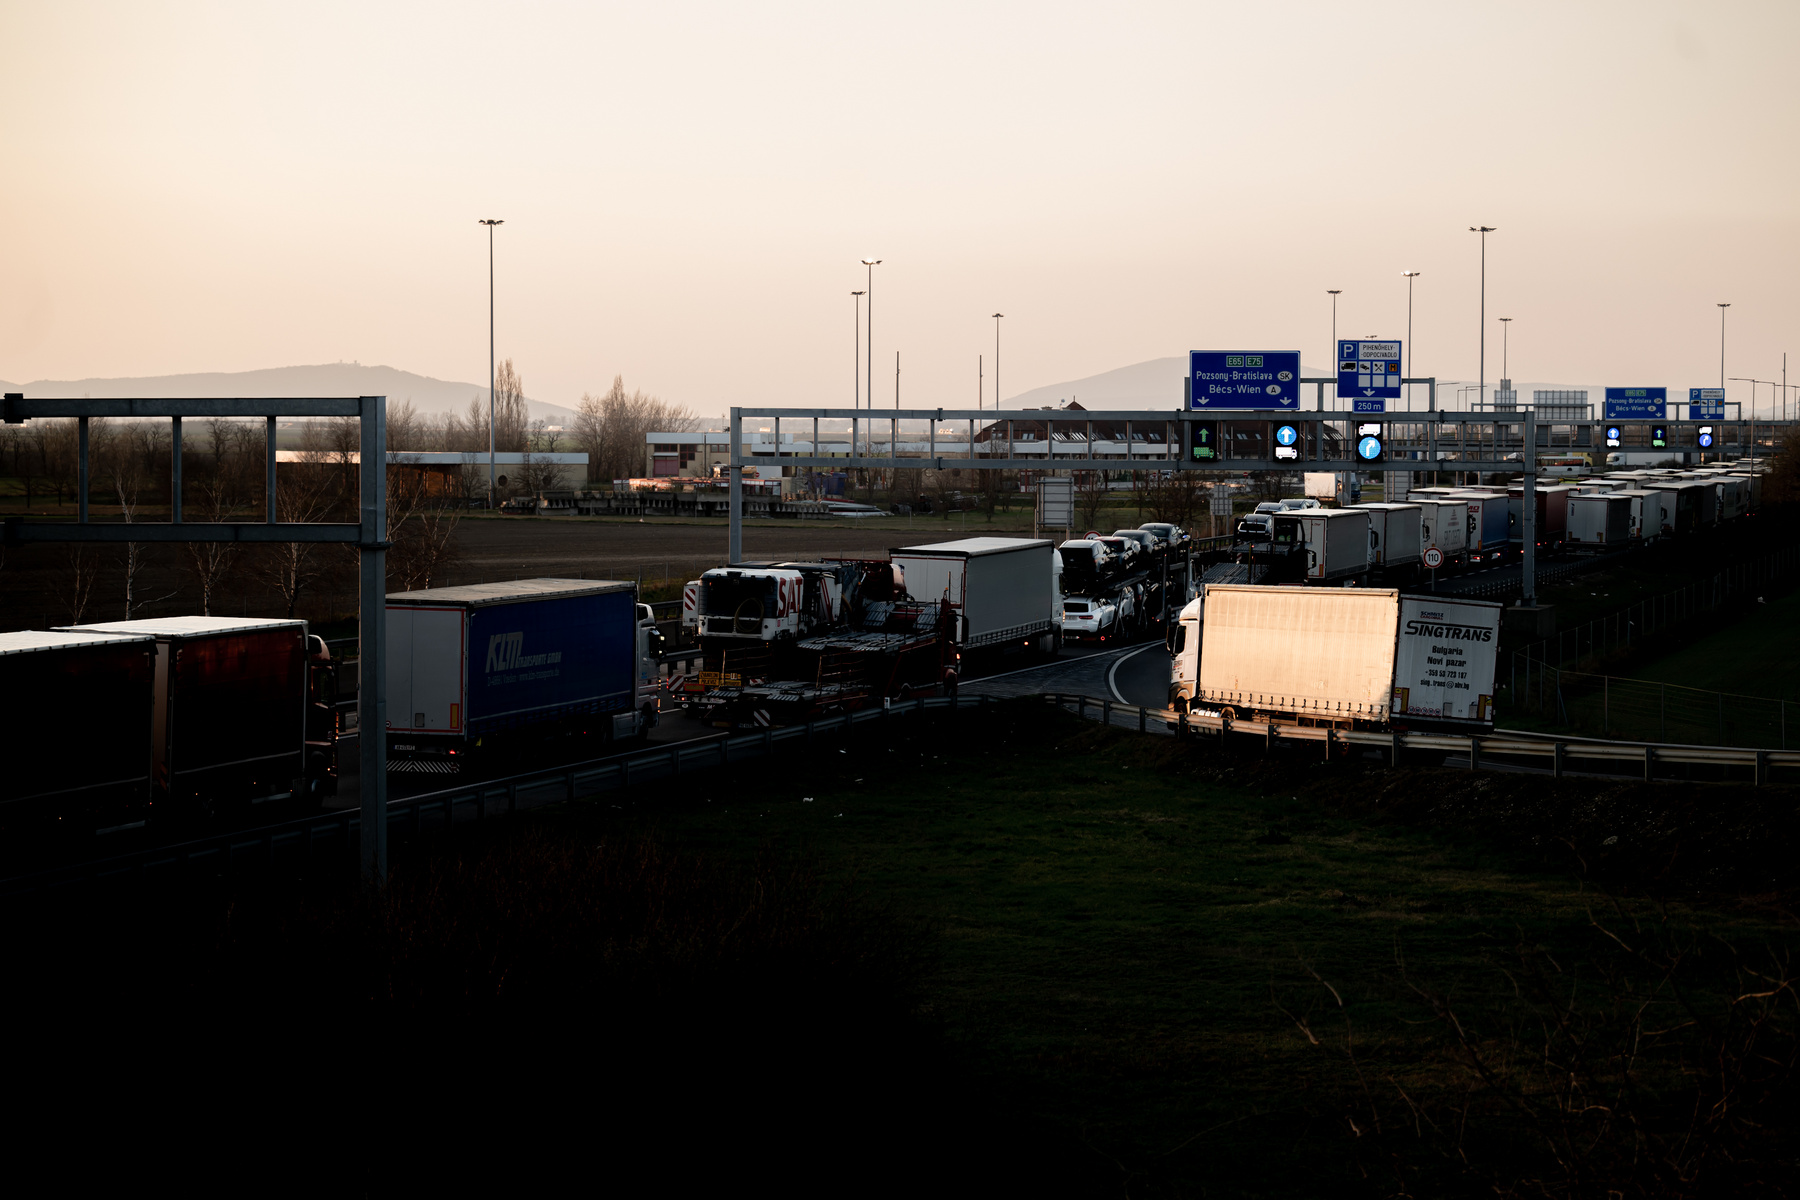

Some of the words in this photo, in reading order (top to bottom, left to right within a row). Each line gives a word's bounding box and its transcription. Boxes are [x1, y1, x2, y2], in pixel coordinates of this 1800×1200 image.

[1343, 344, 1354, 358] P
[1228, 357, 1242, 365] E65
[1247, 357, 1261, 365] E75
[1196, 371, 1273, 382] Pozsony-Bratislava
[1209, 384, 1261, 394] Bécs-Wien
[1270, 386, 1277, 394] A
[1692, 390, 1699, 398] P
[1427, 553, 1439, 562] 110
[778, 577, 803, 617] SAT
[1405, 620, 1493, 642] SINGTRANS
[485, 631, 524, 673] KLM
[1432, 645, 1463, 655] Bulgaria
[1427, 656, 1443, 665] Novi
[1446, 659, 1467, 667] pazar
[1447, 670, 1457, 678] 723
